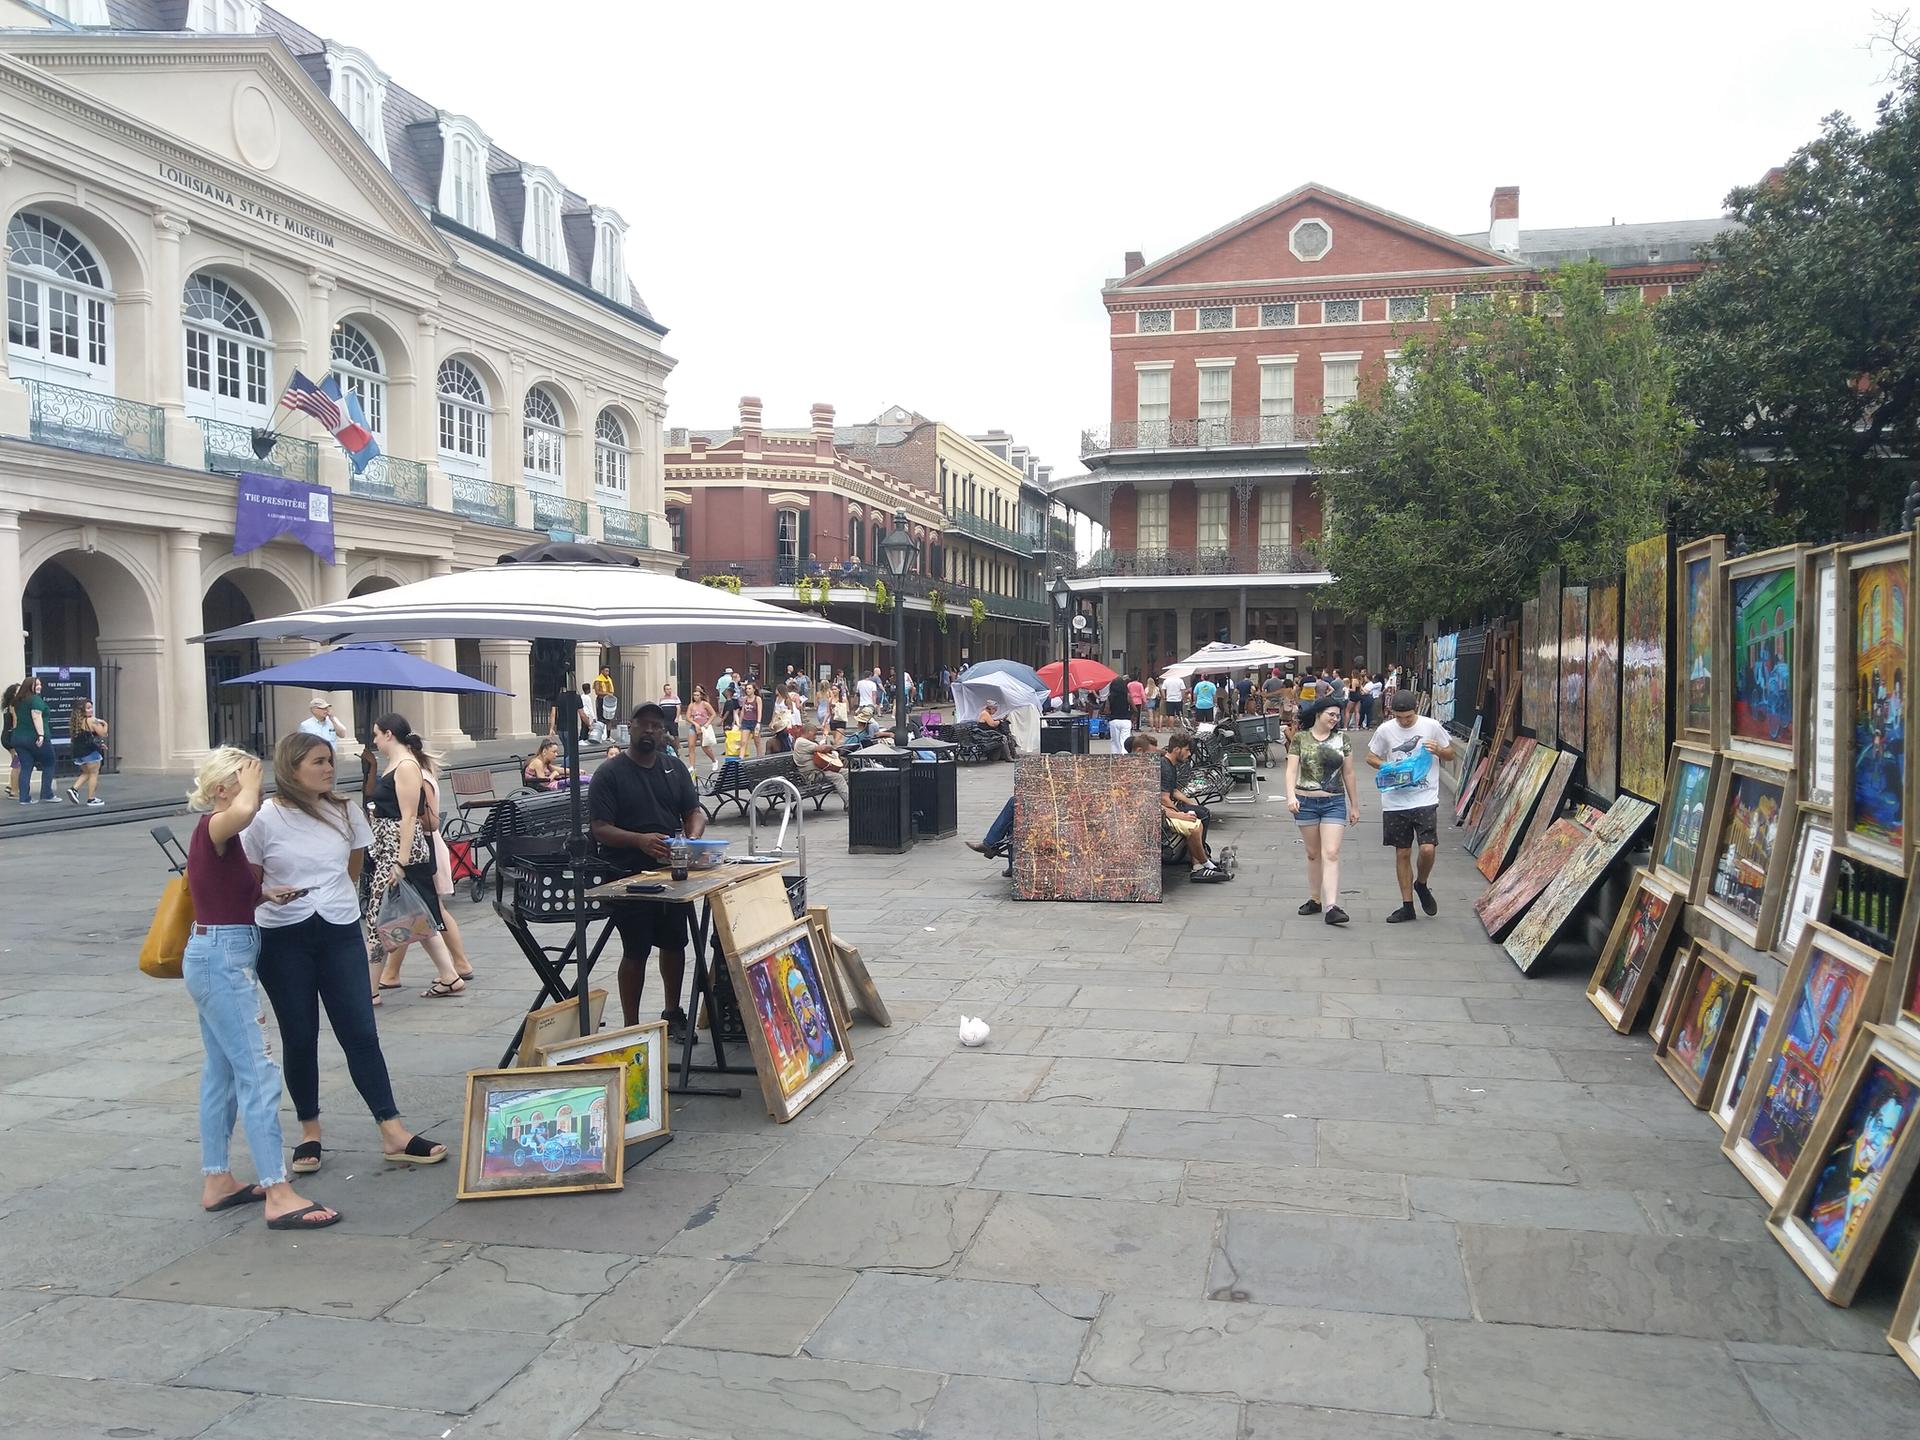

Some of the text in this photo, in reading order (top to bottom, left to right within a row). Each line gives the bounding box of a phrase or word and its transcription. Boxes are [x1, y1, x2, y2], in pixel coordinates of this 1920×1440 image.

[159, 163, 335, 249] LOUISIANA STATE MUSEUM
[244, 492, 260, 503] THE
